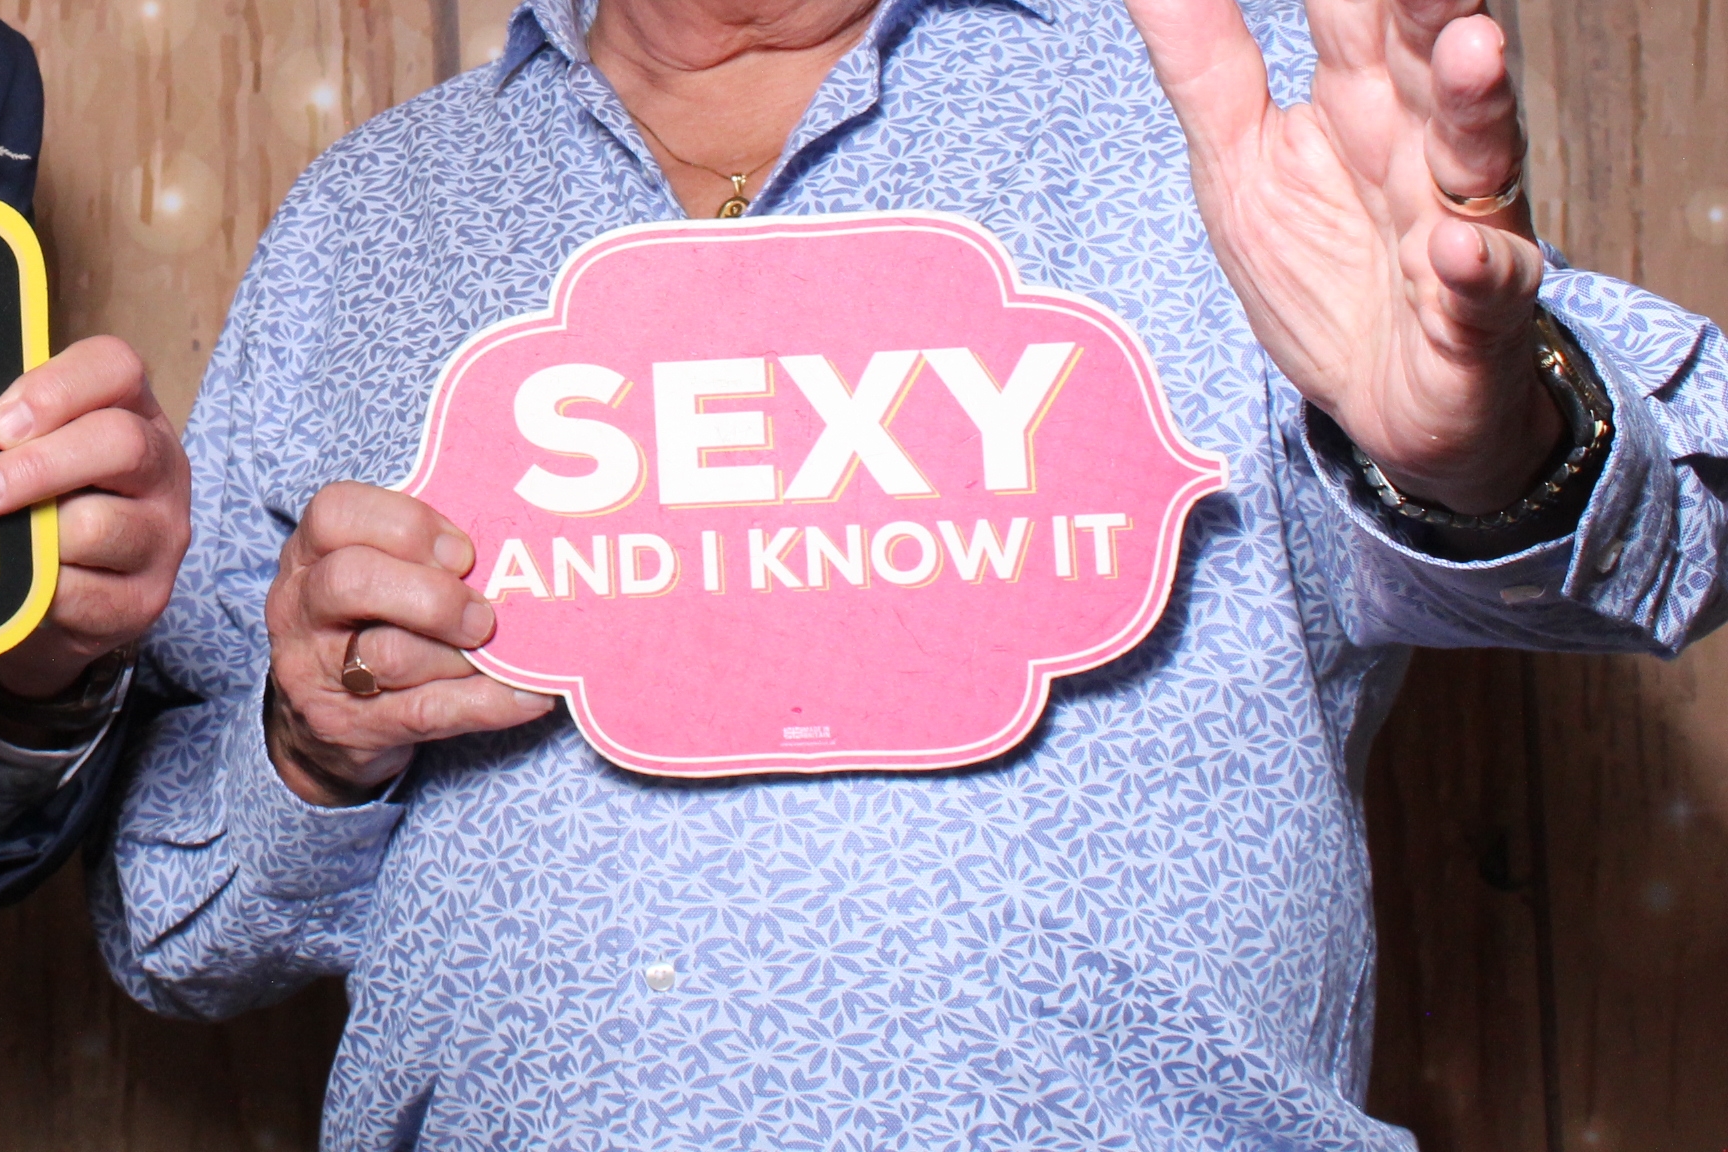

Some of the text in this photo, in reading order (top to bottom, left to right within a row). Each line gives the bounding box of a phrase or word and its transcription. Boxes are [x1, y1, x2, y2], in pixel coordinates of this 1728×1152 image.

[513, 341, 1084, 518] SEXY
[484, 512, 1134, 602] AND I KNOW IT
